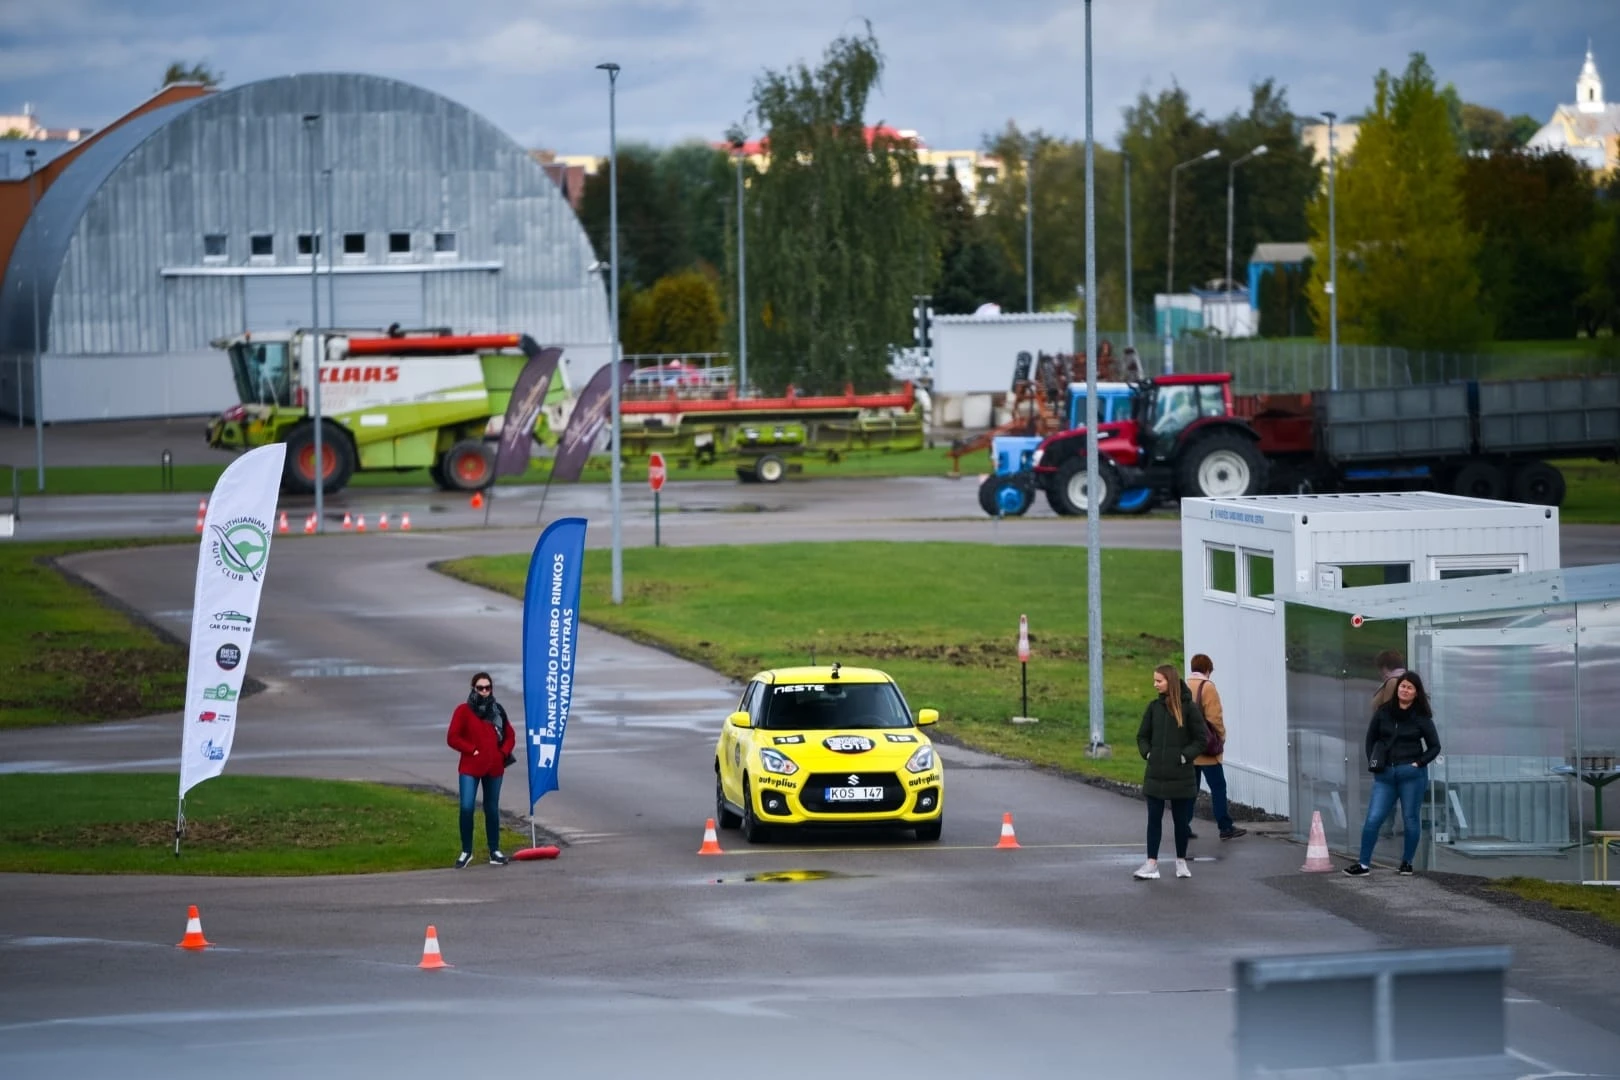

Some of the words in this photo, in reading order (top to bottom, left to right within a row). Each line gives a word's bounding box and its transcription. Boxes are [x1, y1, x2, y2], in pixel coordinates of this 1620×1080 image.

[319, 366, 399, 382] CLAAS
[222, 516, 266, 531] LITHUANIAN
[212, 540, 223, 566] AUTO
[222, 567, 244, 581] CLUB
[551, 553, 564, 605] RINKOS
[549, 608, 560, 657] DARBO
[561, 608, 573, 671] CENTRAS
[546, 660, 558, 737] PANEVĖŽIO
[559, 673, 571, 738] OKYMO
[758, 776, 797, 789] autoplius
[831, 788, 855, 799] KOS
[863, 787, 882, 798] 147
